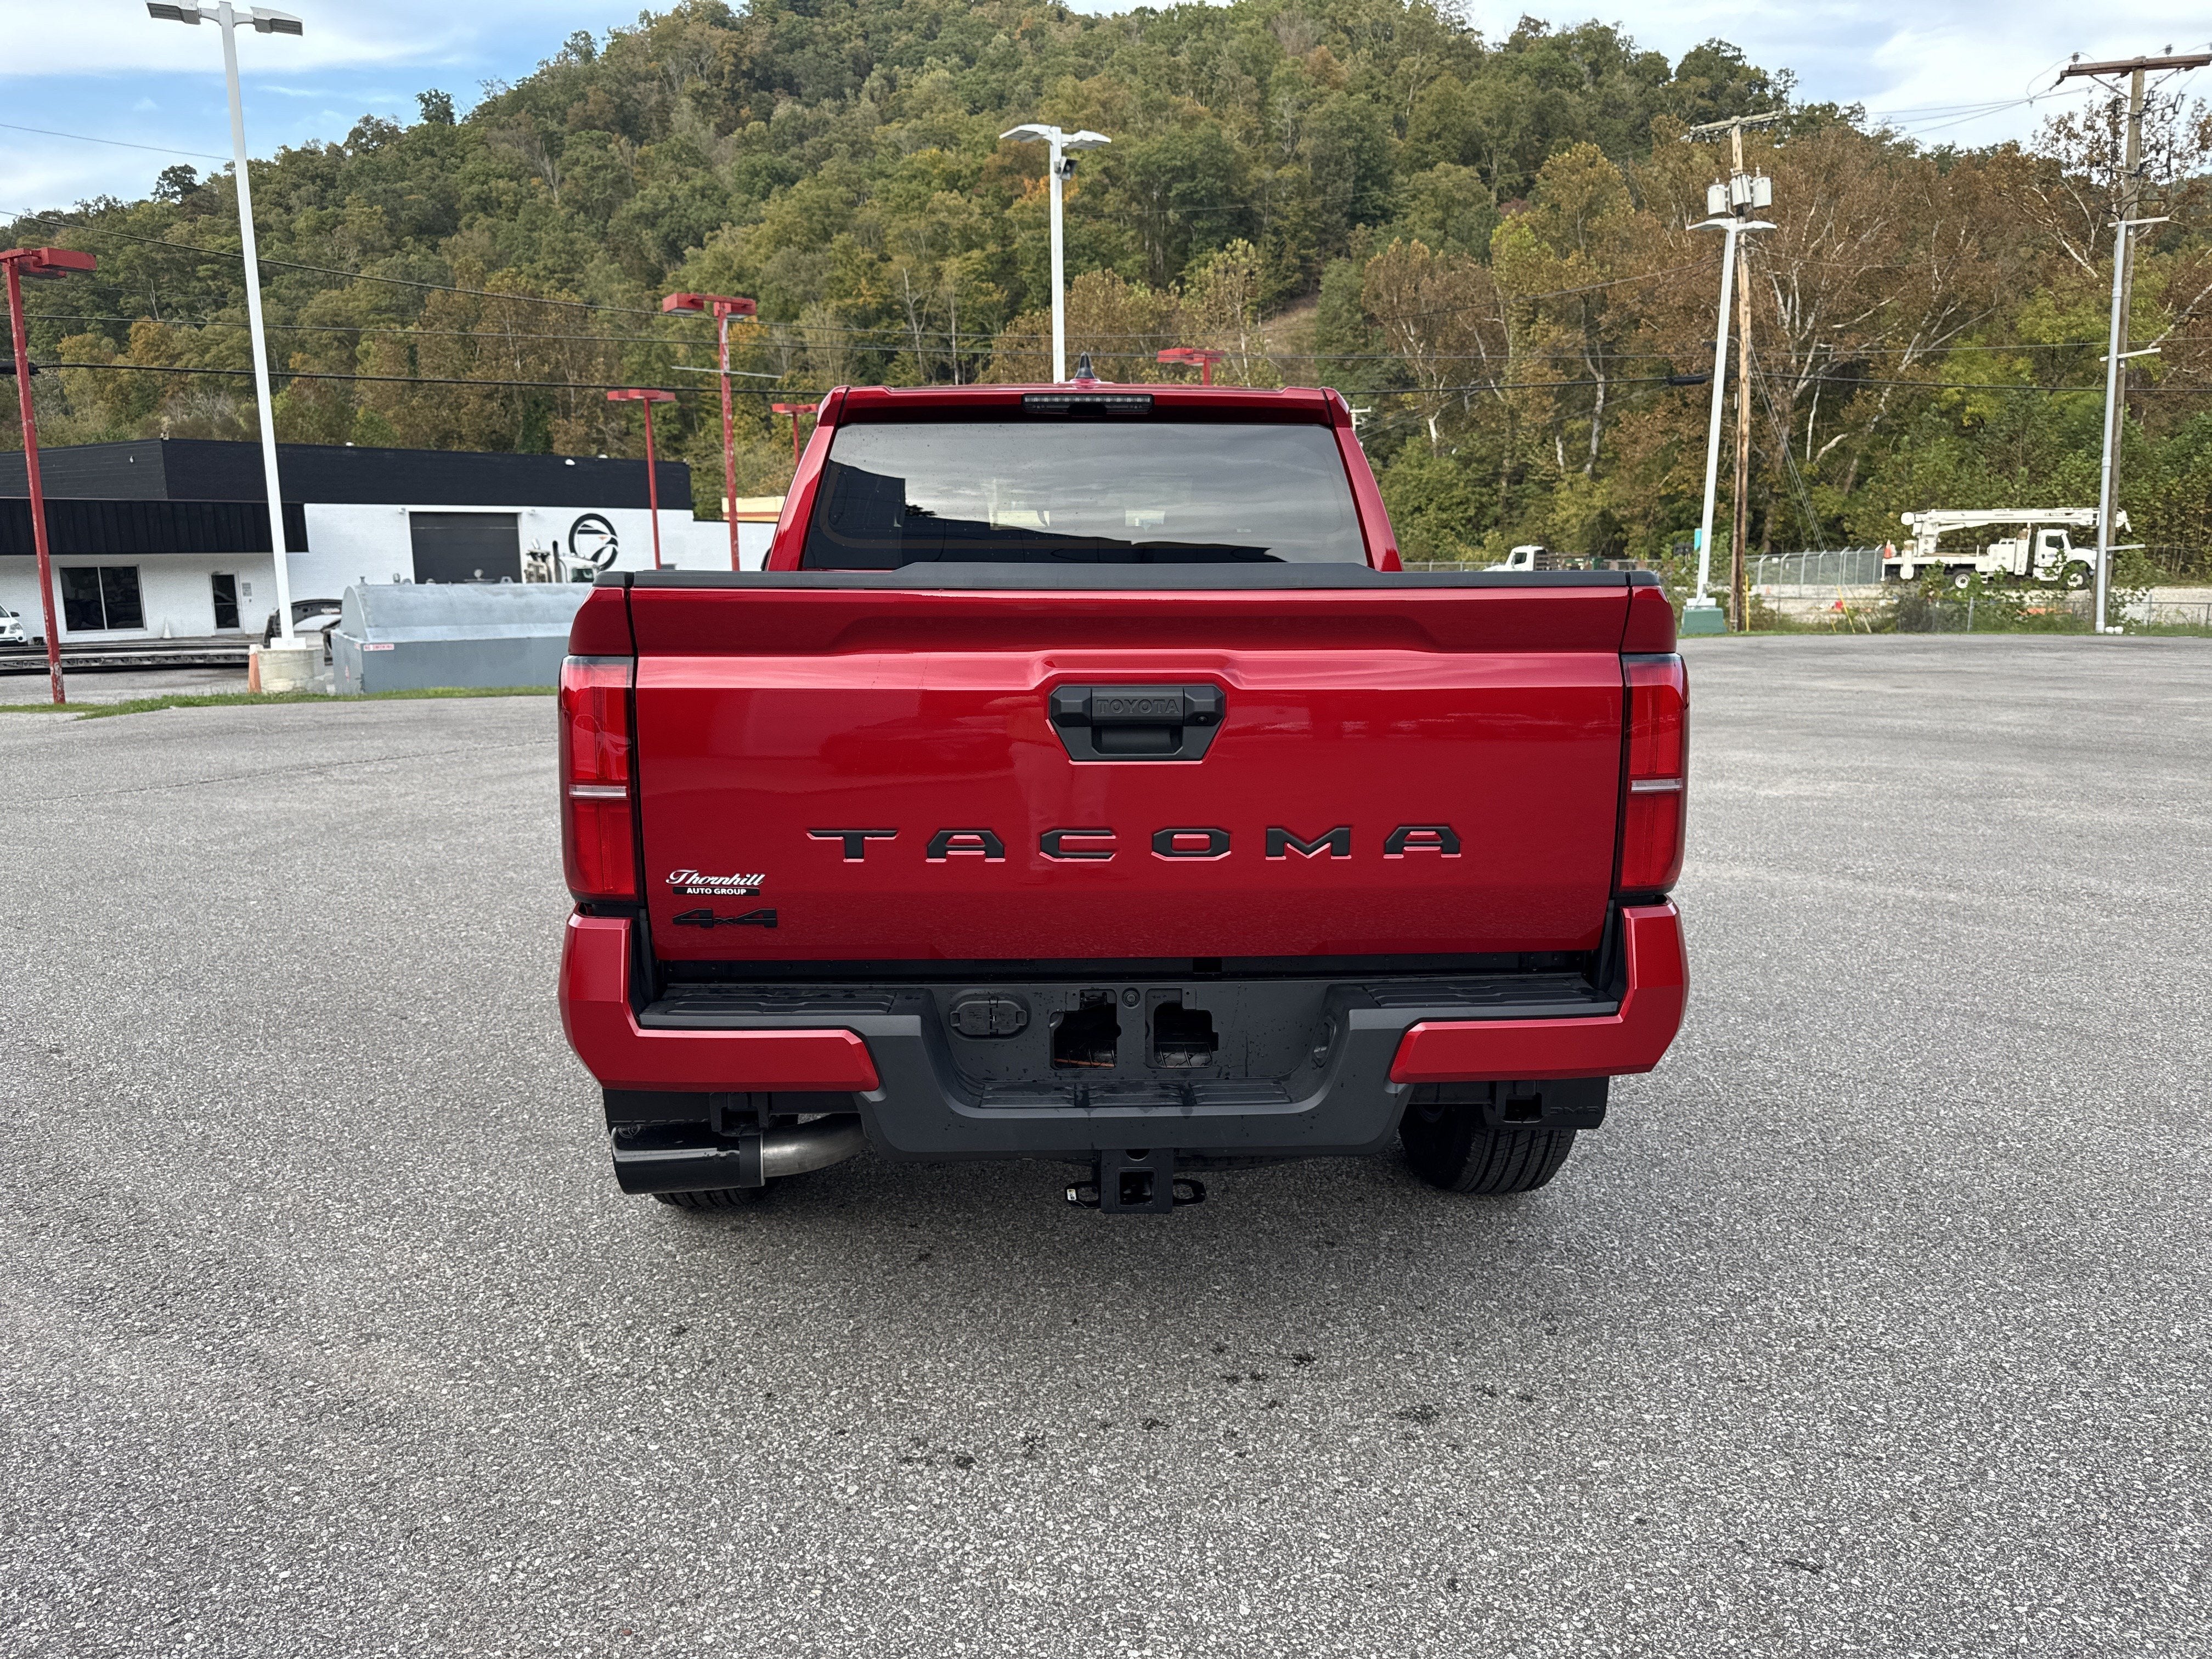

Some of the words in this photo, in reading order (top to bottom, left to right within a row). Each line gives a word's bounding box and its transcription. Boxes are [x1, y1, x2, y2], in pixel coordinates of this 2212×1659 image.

[1097, 699, 1180, 714] TOYOTA
[806, 826, 1462, 862] TACOMA
[665, 869, 766, 886] Thornhill
